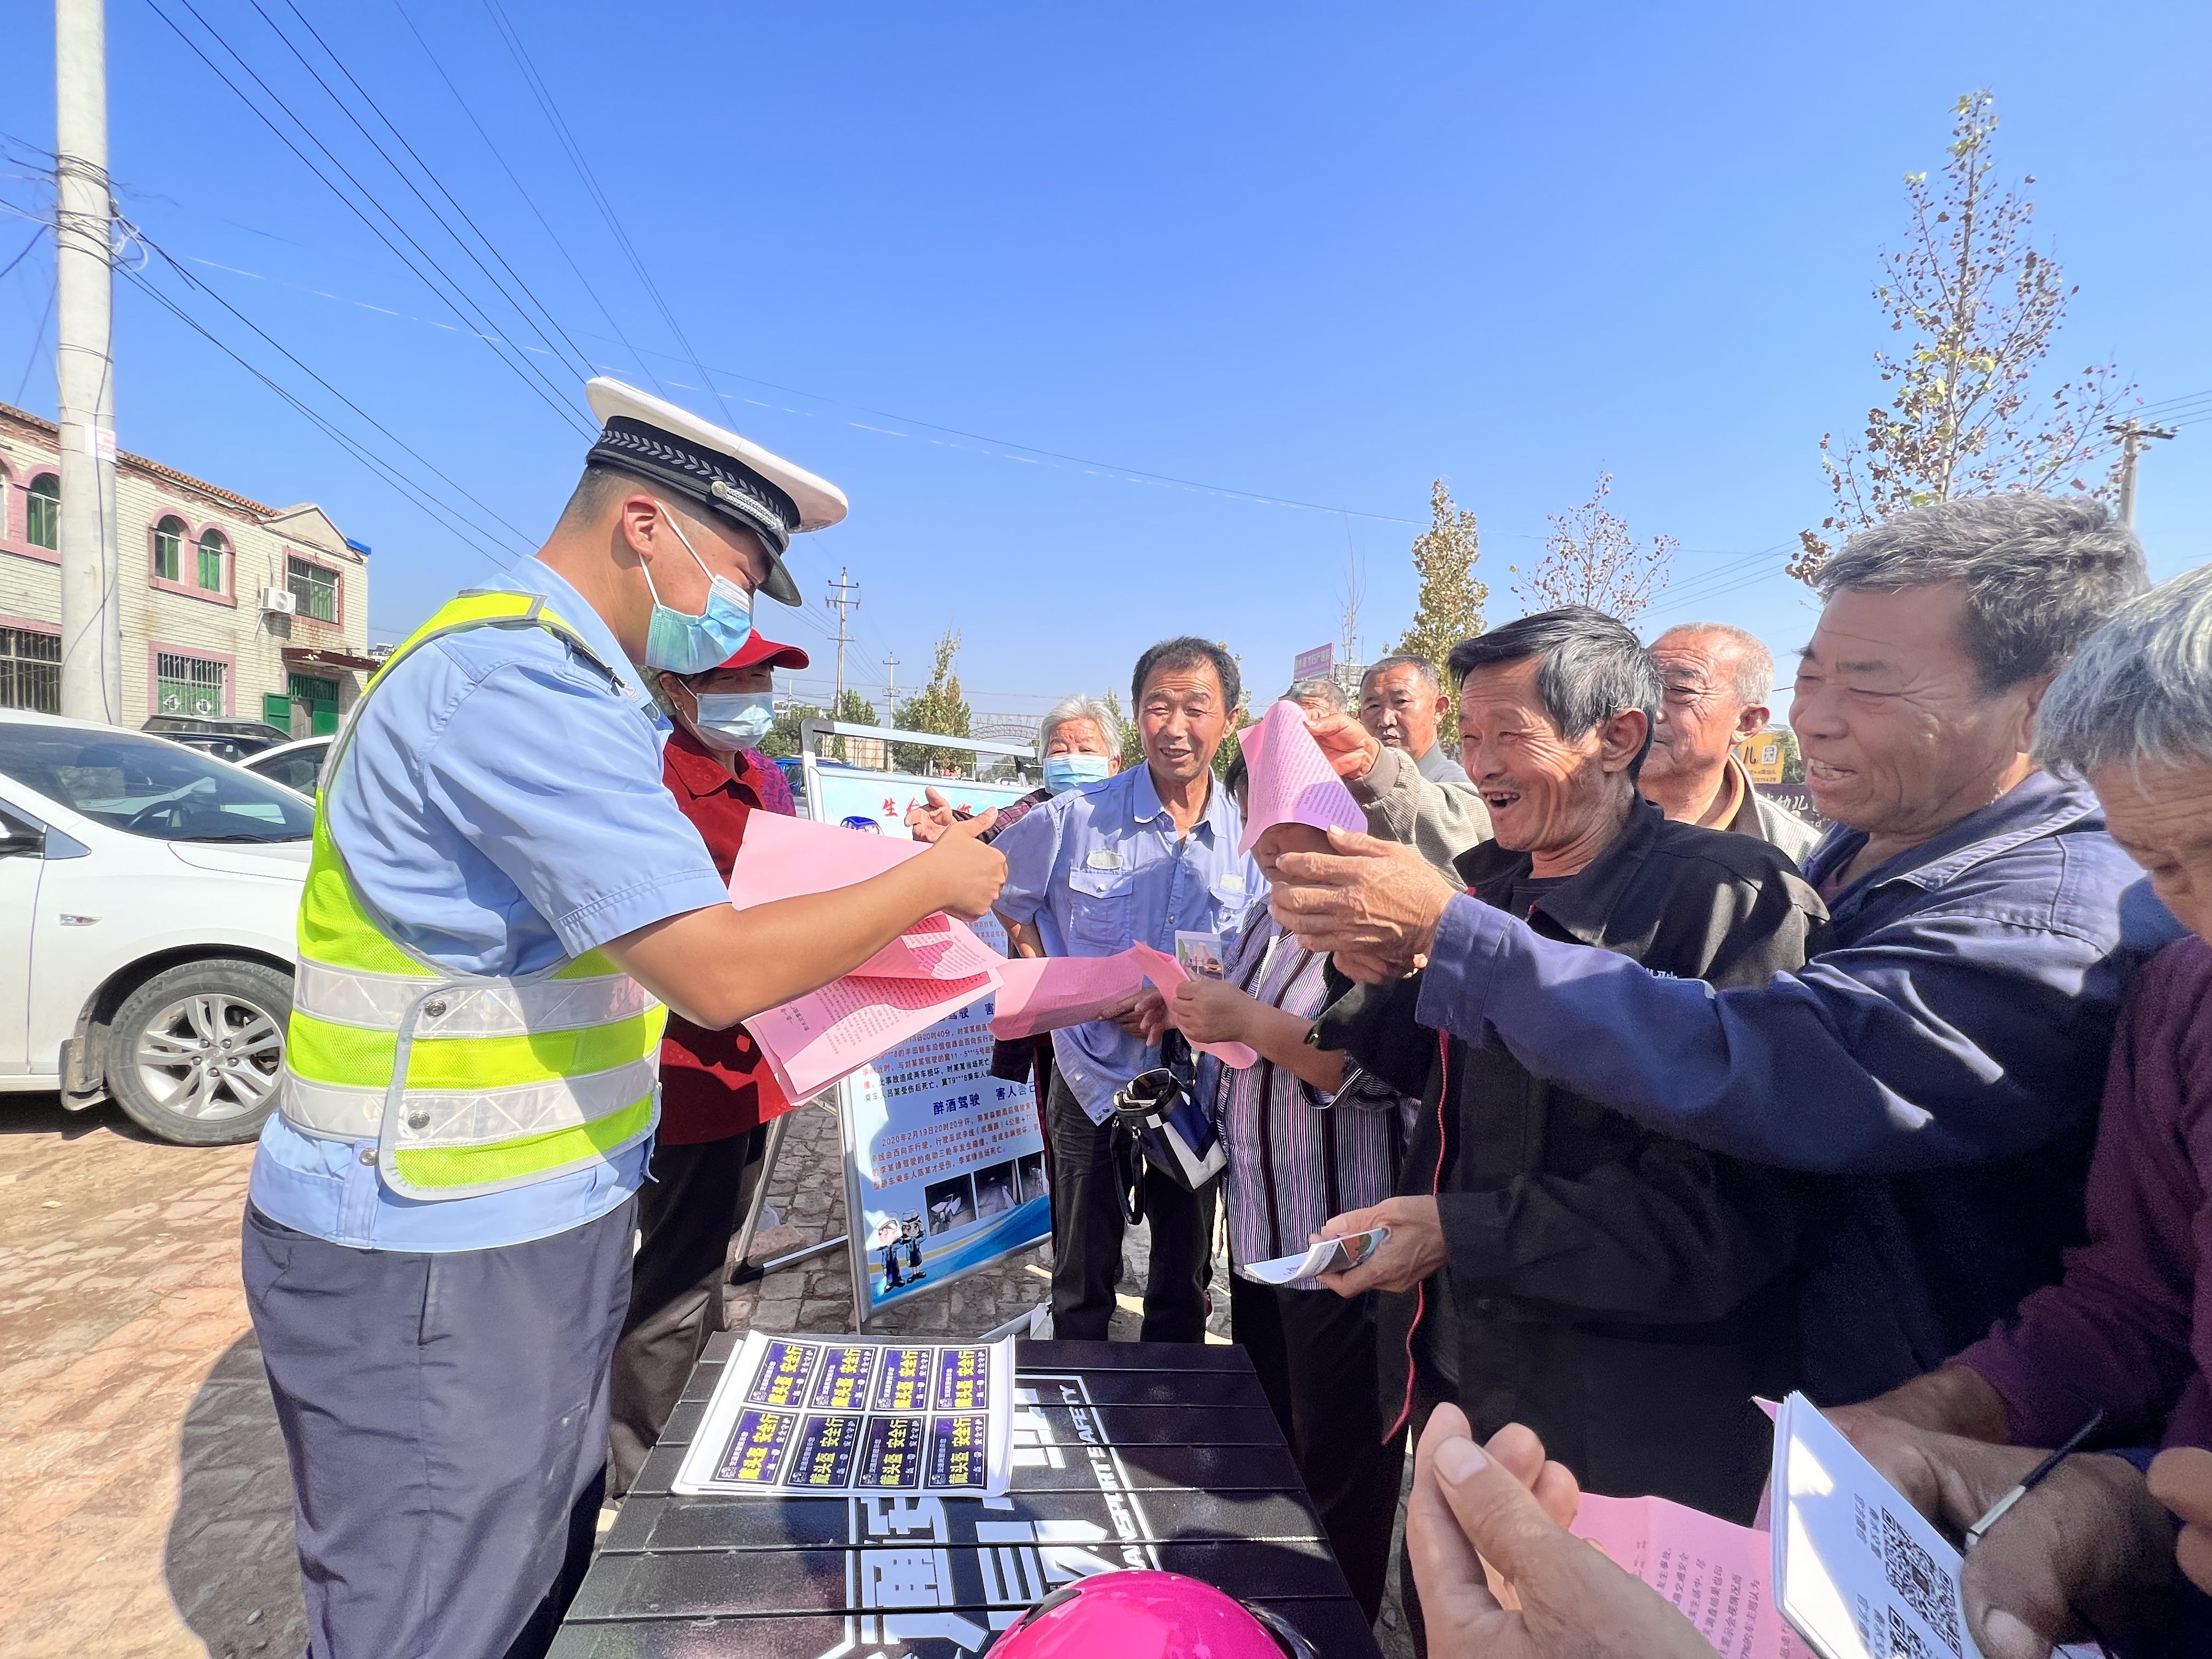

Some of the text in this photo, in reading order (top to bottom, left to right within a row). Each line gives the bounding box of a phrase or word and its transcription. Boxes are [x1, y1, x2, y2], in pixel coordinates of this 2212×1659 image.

[933, 1093, 981, 1116] 醉酒驾驶
[768, 1345, 804, 1404] 戴头盔 安全行
[831, 1348, 862, 1407] 戴头盔 安全行
[893, 1350, 918, 1408] 戴头盔 安全行
[955, 1350, 975, 1408] 戴头盔 安全行
[738, 1413, 780, 1480] 戴头盔 安全行
[809, 1418, 844, 1485] 戴头盔 安全行
[880, 1419, 908, 1485] 戴头盔 安全行
[949, 1417, 972, 1485] 戴头盔 安全行
[1059, 1384, 1147, 1570] ANSPORT SAFETY
[1672, 1552, 1689, 1606] 路交通安全
